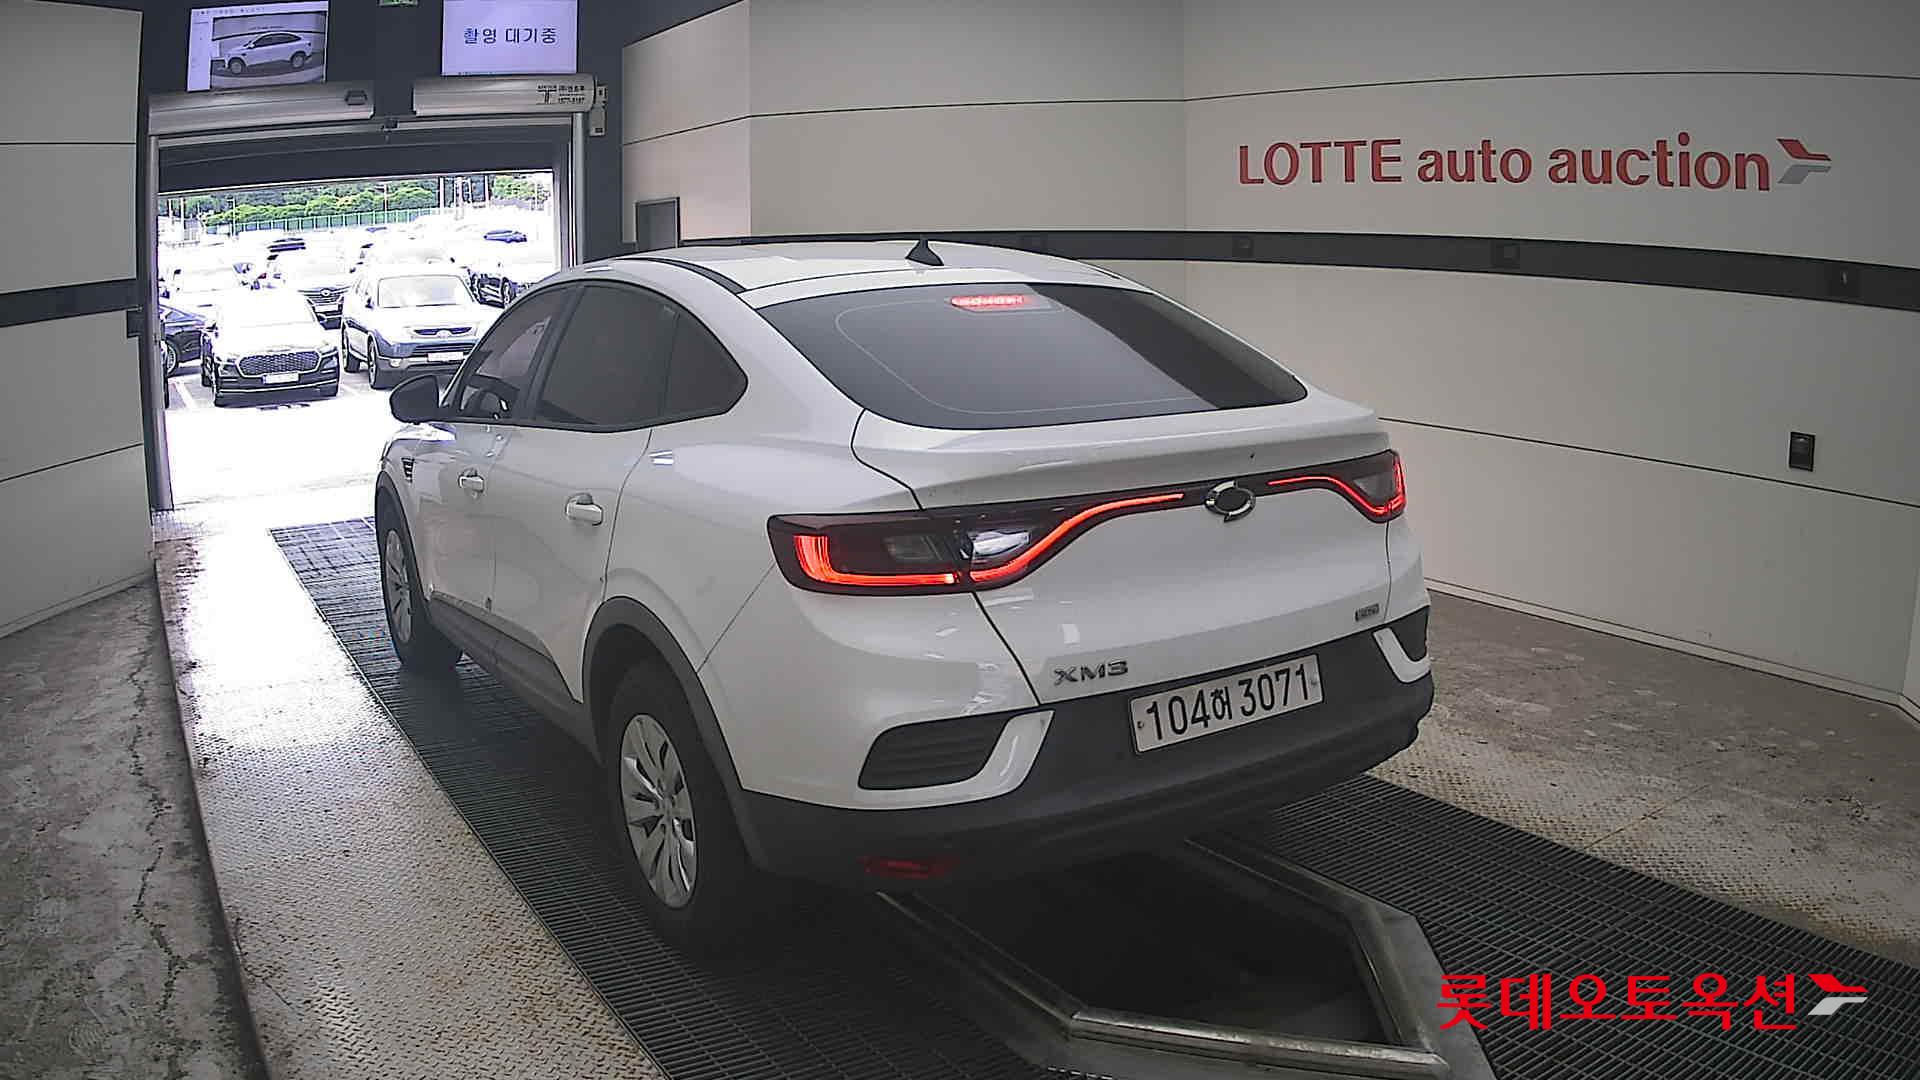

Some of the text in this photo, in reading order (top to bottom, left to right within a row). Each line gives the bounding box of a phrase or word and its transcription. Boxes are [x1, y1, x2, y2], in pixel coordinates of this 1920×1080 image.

[464, 28, 557, 44] 촬영 대기중
[1239, 131, 1771, 192] LOTTE auto auction
[1054, 660, 1129, 686] XM3
